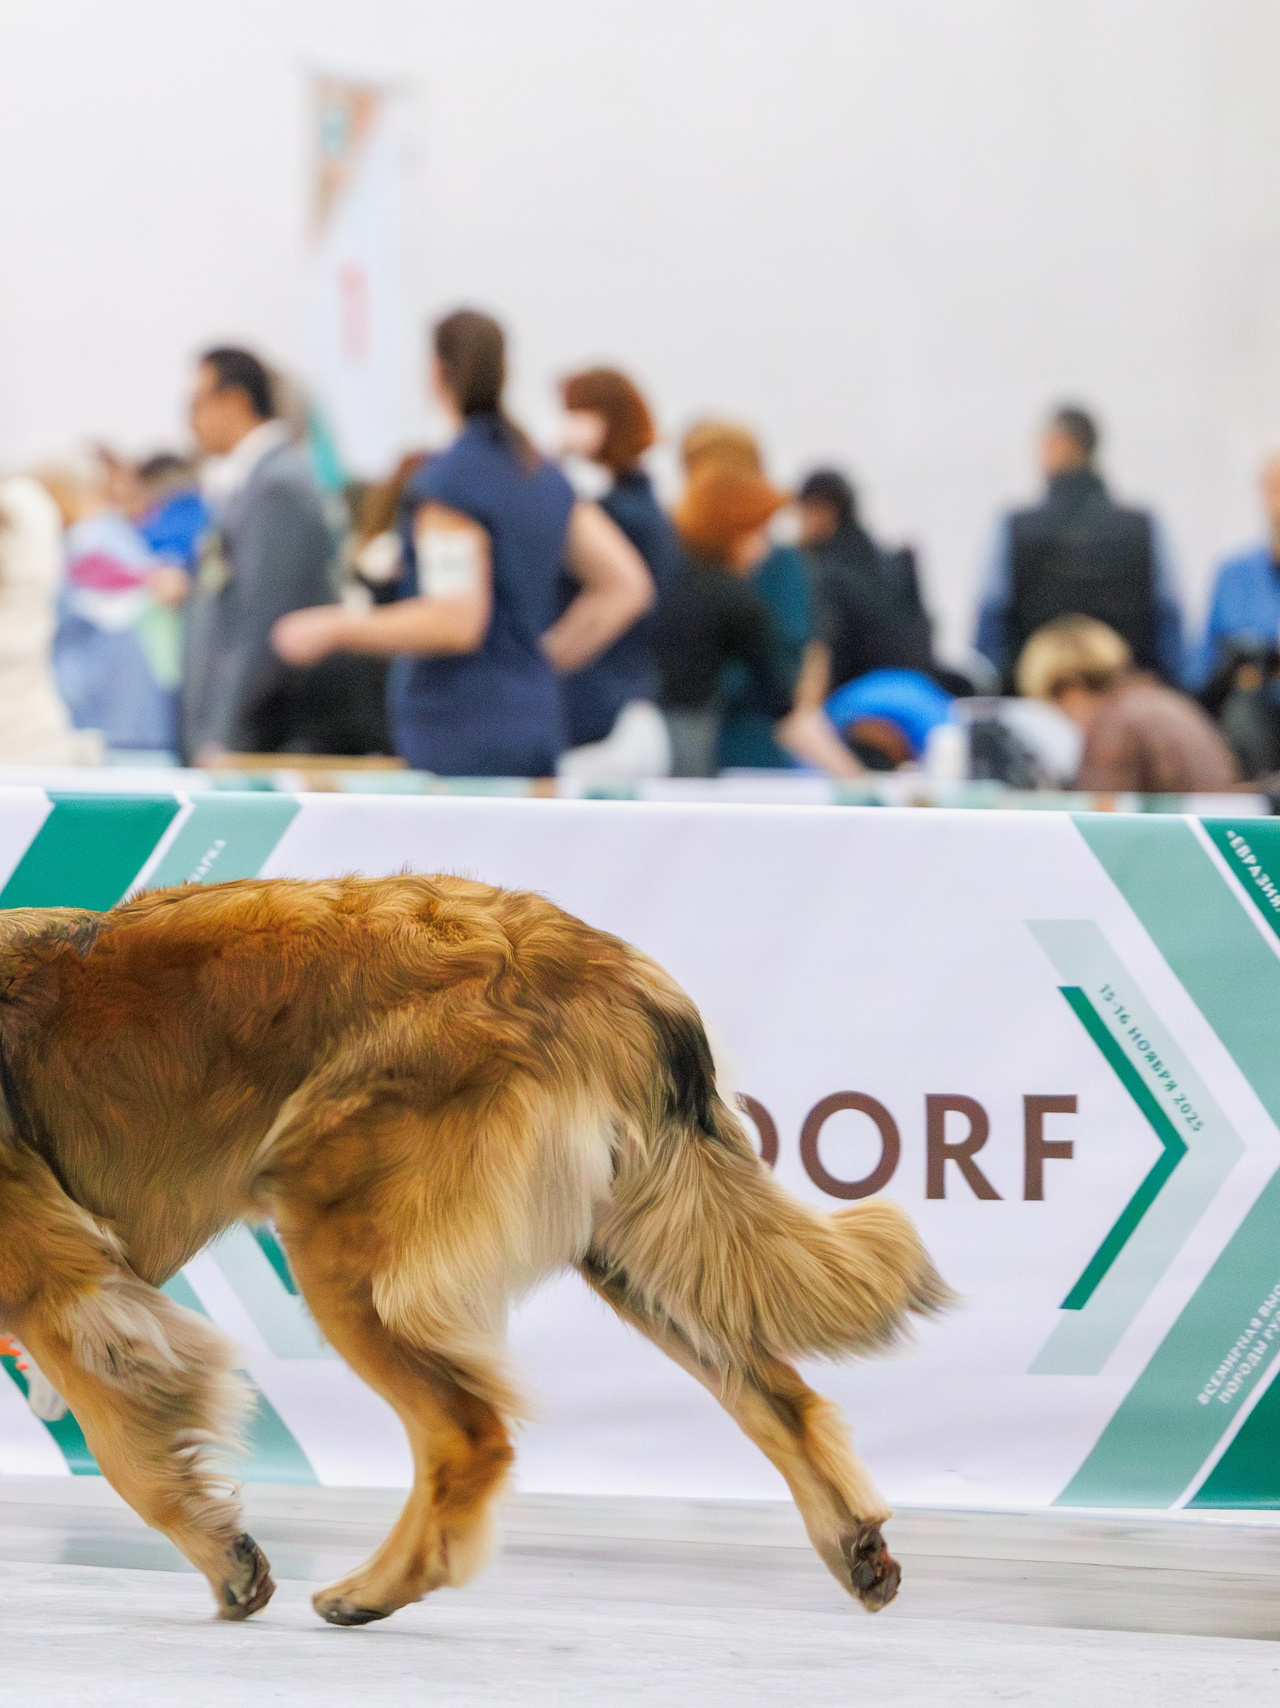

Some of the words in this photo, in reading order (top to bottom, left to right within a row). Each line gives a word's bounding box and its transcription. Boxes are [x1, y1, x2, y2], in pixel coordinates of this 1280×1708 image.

[1099, 983, 1130, 1025] 15-16
[1128, 1026, 1178, 1092] НОЯБРЯ
[1174, 1093, 1204, 1132] 2025
[1197, 1316, 1263, 1405] ВСЕМИРНАЯ
[1218, 1340, 1268, 1404] ПОРОДЫ
